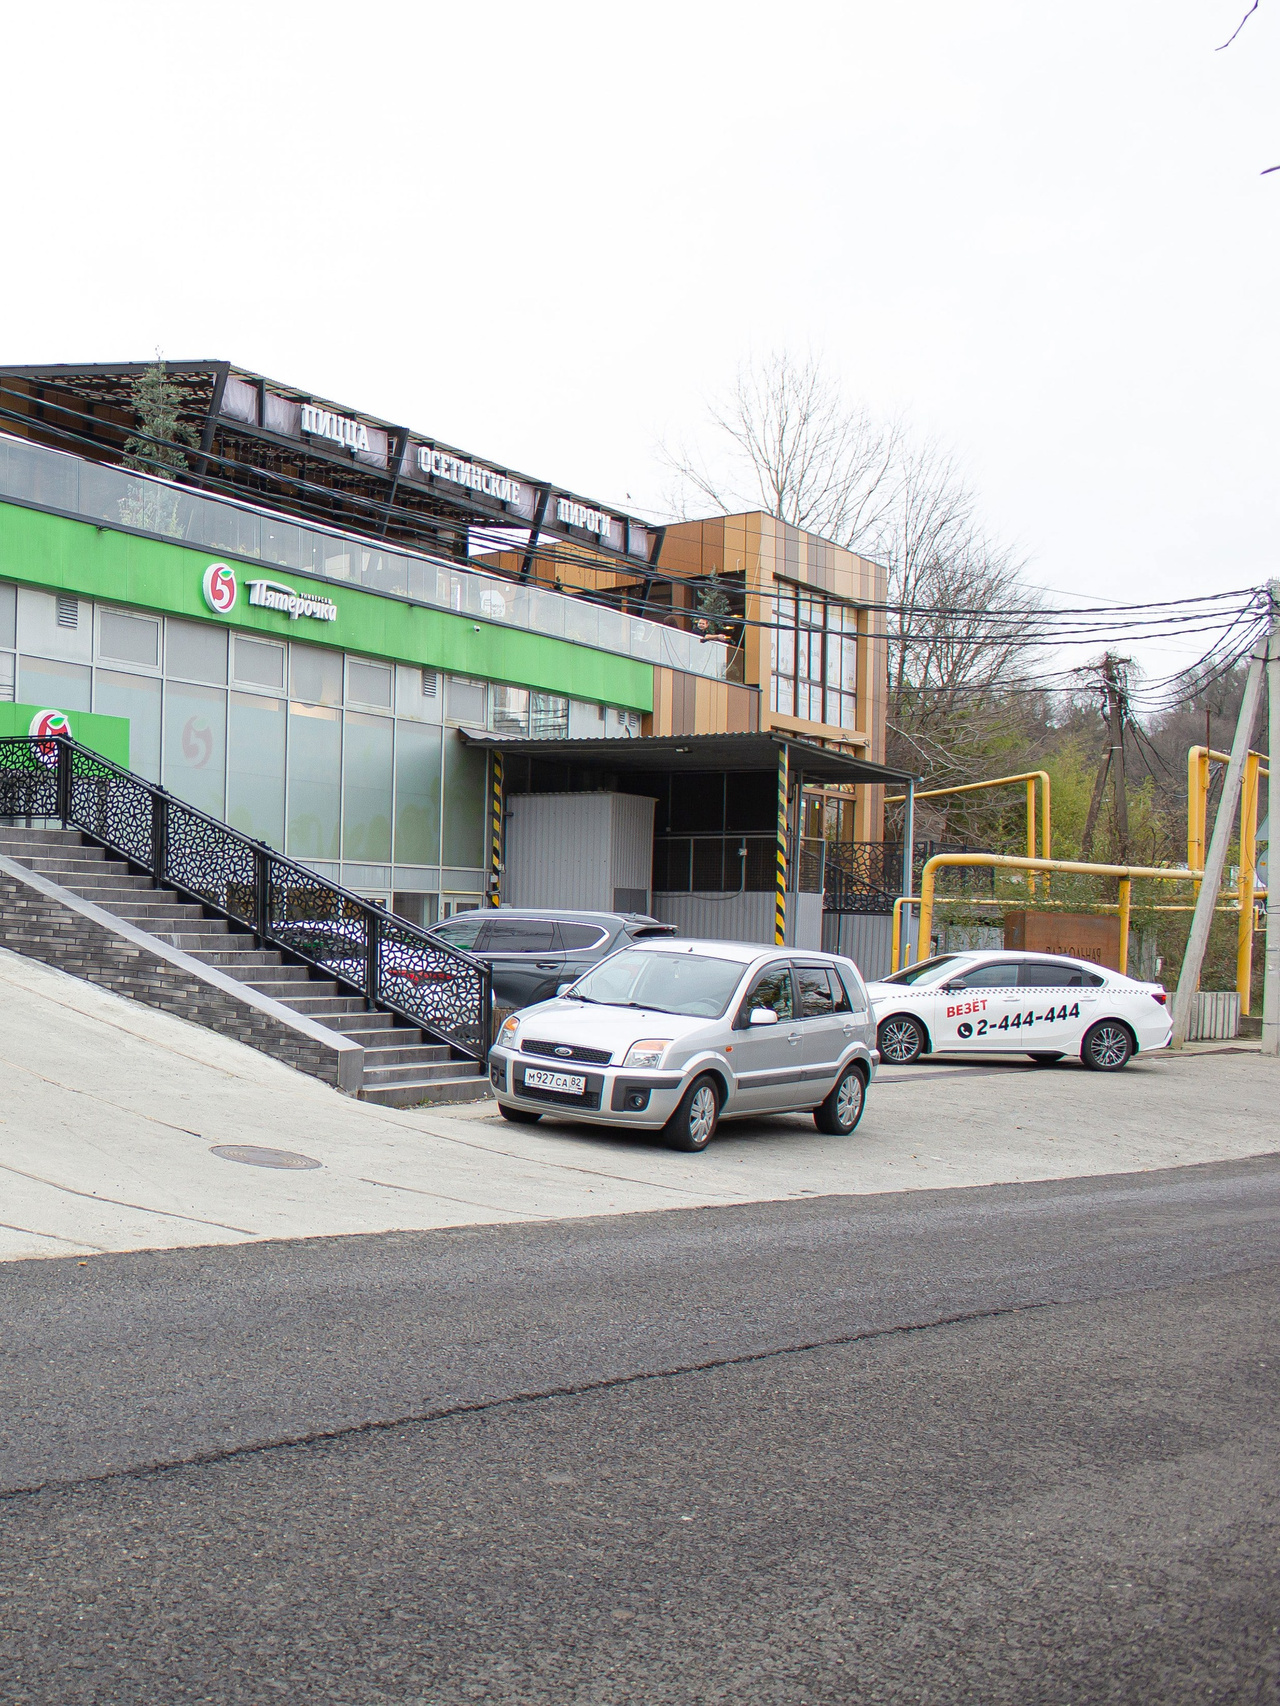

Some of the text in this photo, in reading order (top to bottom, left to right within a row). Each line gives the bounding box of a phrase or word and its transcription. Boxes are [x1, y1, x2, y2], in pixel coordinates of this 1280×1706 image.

[301, 403, 370, 453] ПИЦЦА
[418, 446, 520, 505] ОСЕТИНСКИЕ
[556, 498, 611, 538] ПИРОГИ
[244, 579, 337, 621] Пятерочка
[947, 998, 988, 1018] ВЕЗЁТ
[976, 1002, 1080, 1036] 2-444-444
[570, 1075, 581, 1087] 82
